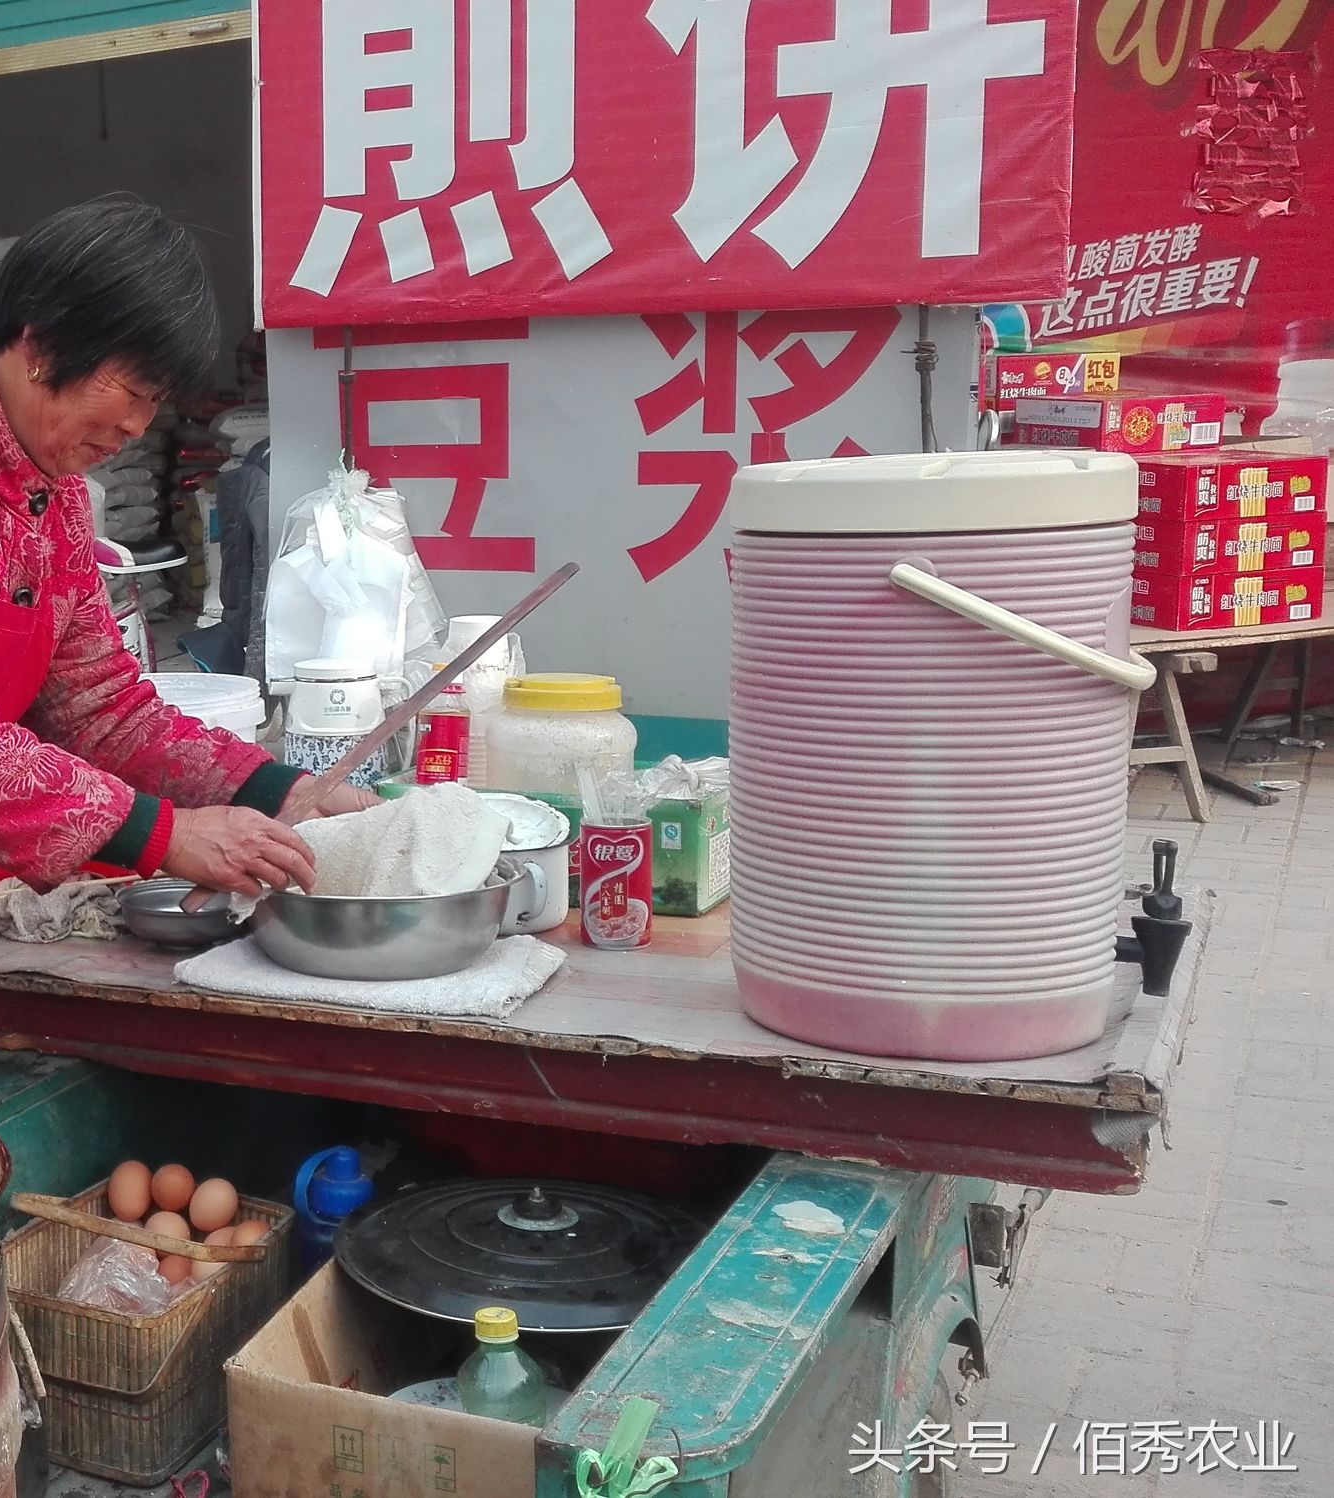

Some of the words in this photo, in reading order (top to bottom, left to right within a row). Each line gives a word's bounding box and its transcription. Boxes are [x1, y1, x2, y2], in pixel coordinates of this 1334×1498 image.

[290, 0, 1046, 297] 煎饼
[1034, 256, 1261, 341] 这点很重要!
[1087, 359, 1116, 379] 红包
[1226, 481, 1284, 501] 红烧牛肉面
[1224, 535, 1283, 556] 红烧牛肉面
[1220, 589, 1280, 610] 红烧牛肉面
[594, 843, 636, 862] 银鹭
